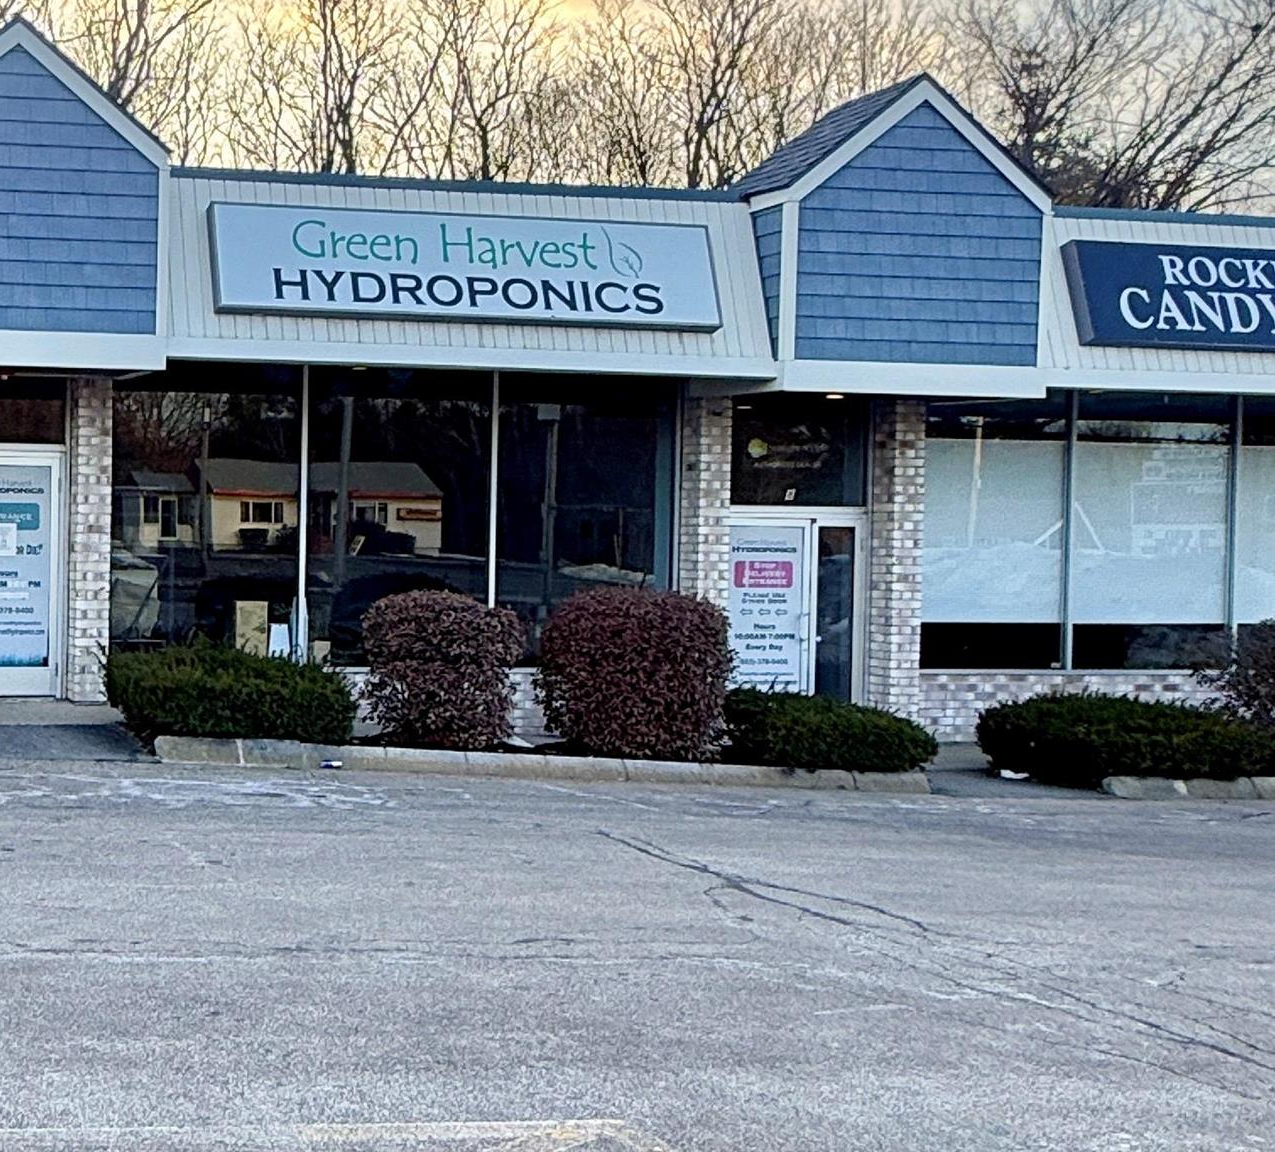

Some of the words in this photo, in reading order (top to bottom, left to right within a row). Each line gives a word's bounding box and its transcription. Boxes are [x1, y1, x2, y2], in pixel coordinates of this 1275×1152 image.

[292, 219, 418, 265] Green
[439, 223, 598, 270] Harvest
[272, 268, 665, 315] HYDROPONICS
[1158, 254, 1275, 289] ROCK
[28, 580, 41, 588] PM
